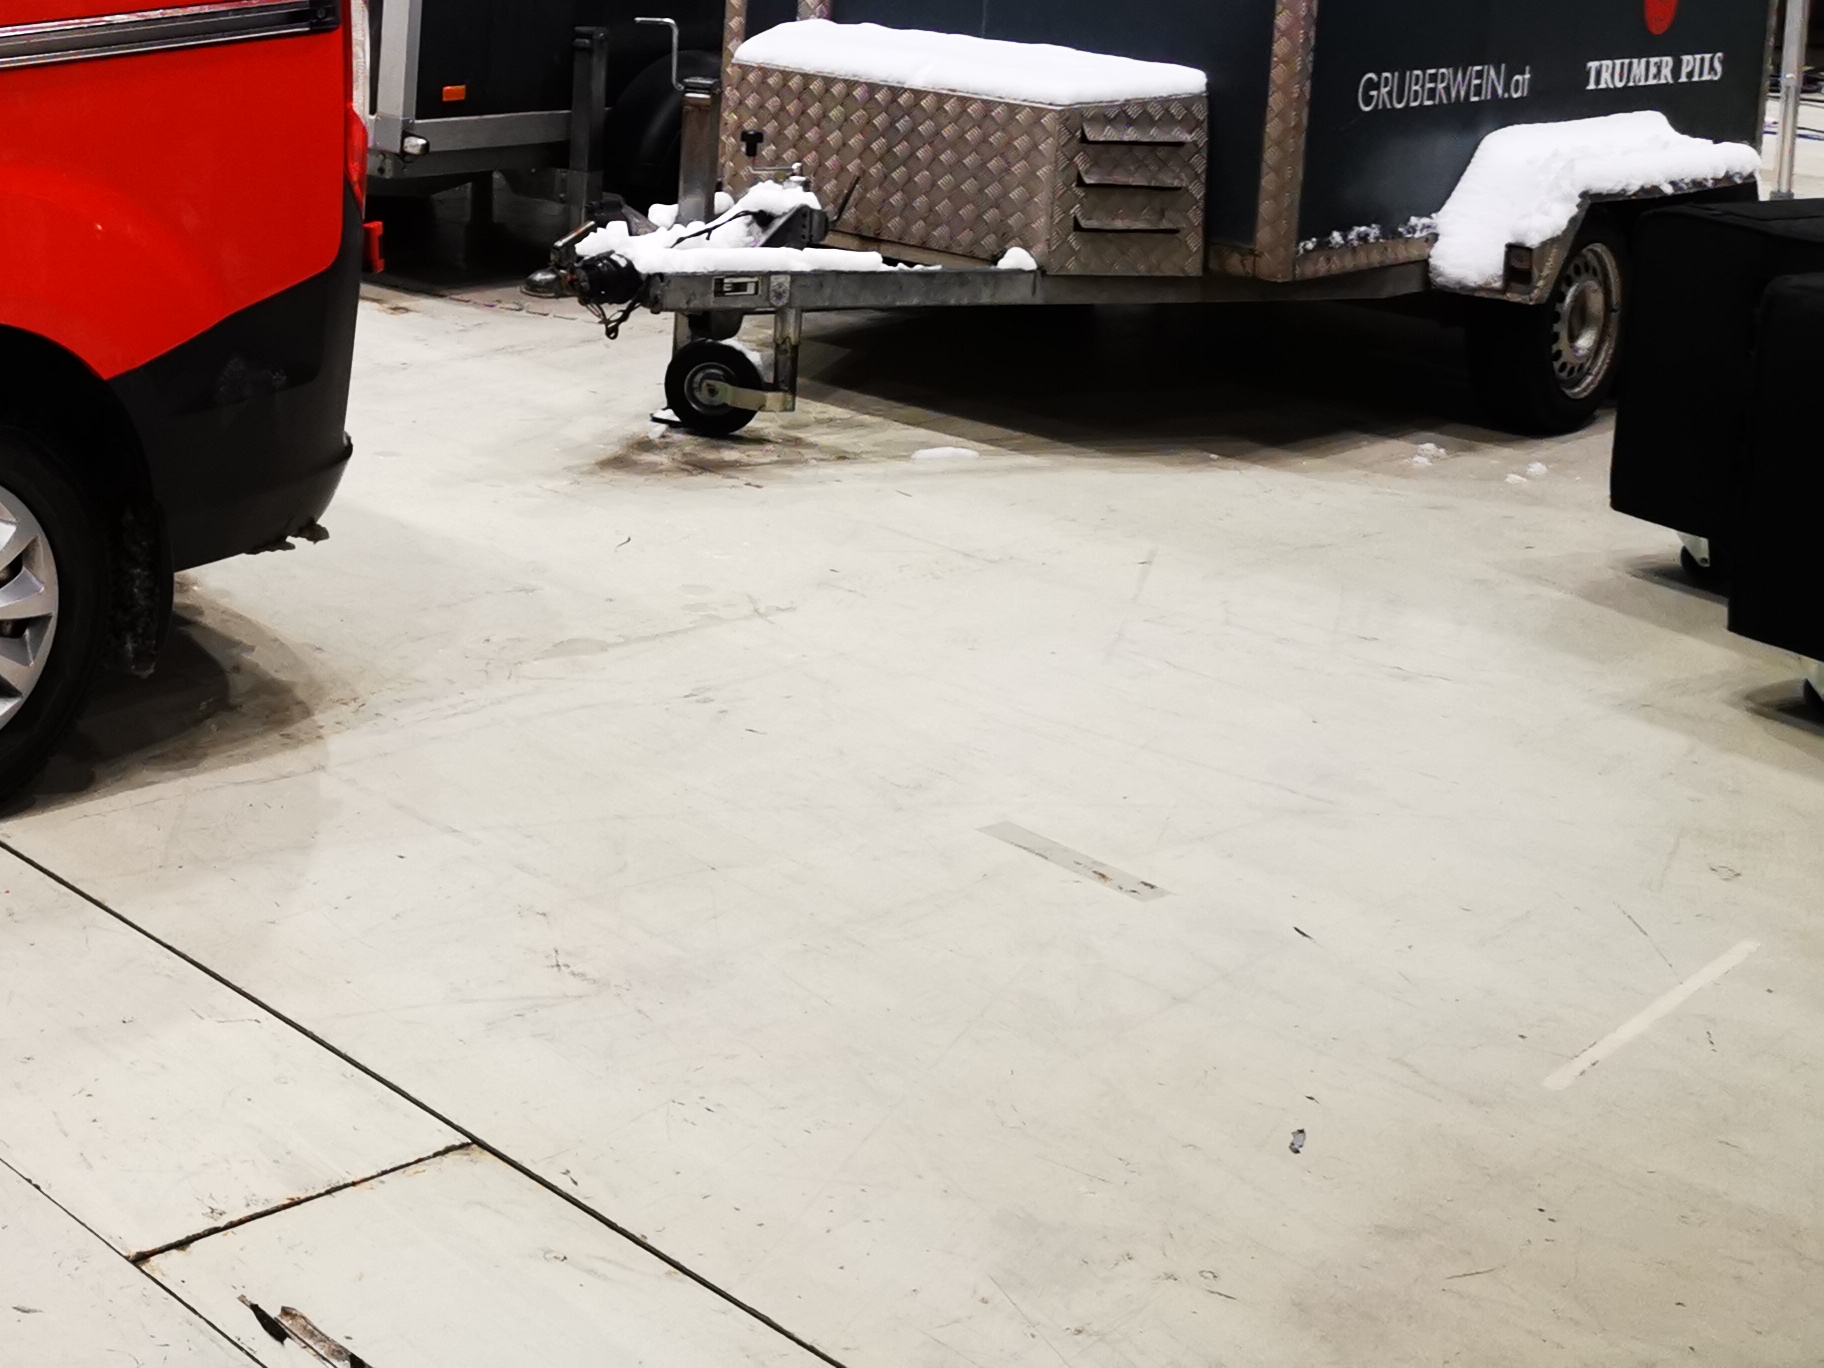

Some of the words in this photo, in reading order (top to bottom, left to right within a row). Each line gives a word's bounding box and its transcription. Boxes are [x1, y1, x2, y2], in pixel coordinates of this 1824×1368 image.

[1358, 64, 1531, 112] GRUBERWEIN.at
[1586, 55, 1674, 91] TRUMER
[1676, 52, 1724, 84] PILS
